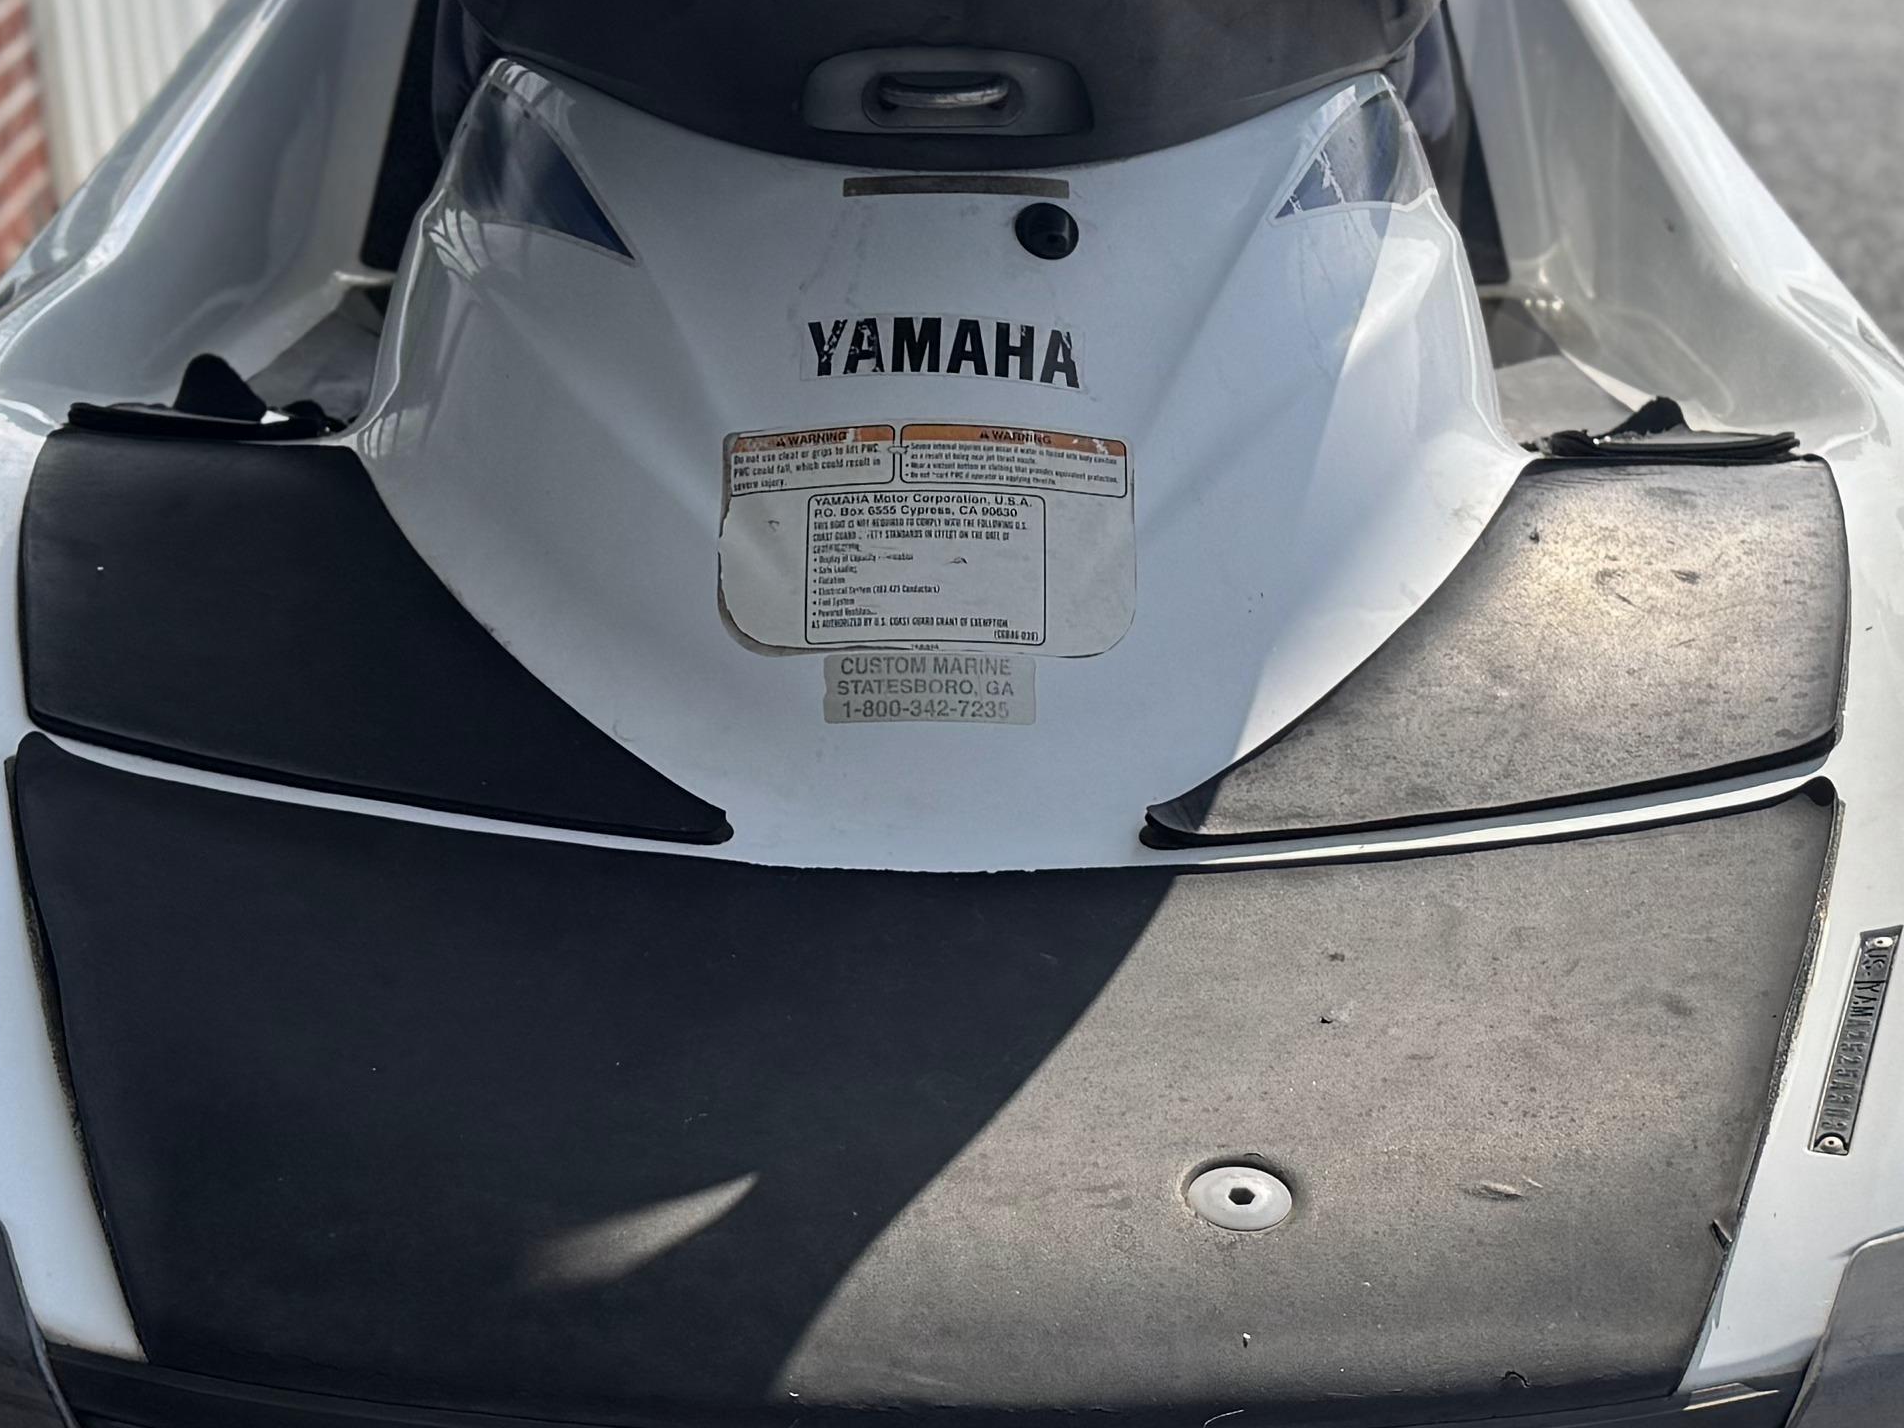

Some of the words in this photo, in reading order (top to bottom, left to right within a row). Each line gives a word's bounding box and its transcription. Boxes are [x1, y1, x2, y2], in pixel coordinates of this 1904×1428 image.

[807, 317, 1080, 388] YAMAHA
[788, 431, 847, 446] WARNING
[992, 430, 1051, 444] WARNING
[814, 494, 869, 506] YAMAHA
[873, 493, 908, 503] Motor
[913, 493, 990, 506] Corporation,
[995, 495, 1033, 508] U.S.A.
[814, 508, 837, 519] P.O.
[840, 507, 865, 517] Box
[900, 505, 955, 517] Cypress,
[959, 505, 978, 516] CA
[982, 506, 1018, 518] 90630
[841, 657, 926, 675] CUSTOM
[933, 657, 1012, 676] MARINE
[837, 679, 978, 697] STATESBORO,
[985, 680, 1014, 697] GA
[842, 700, 1010, 718] 1-800-342-7235
